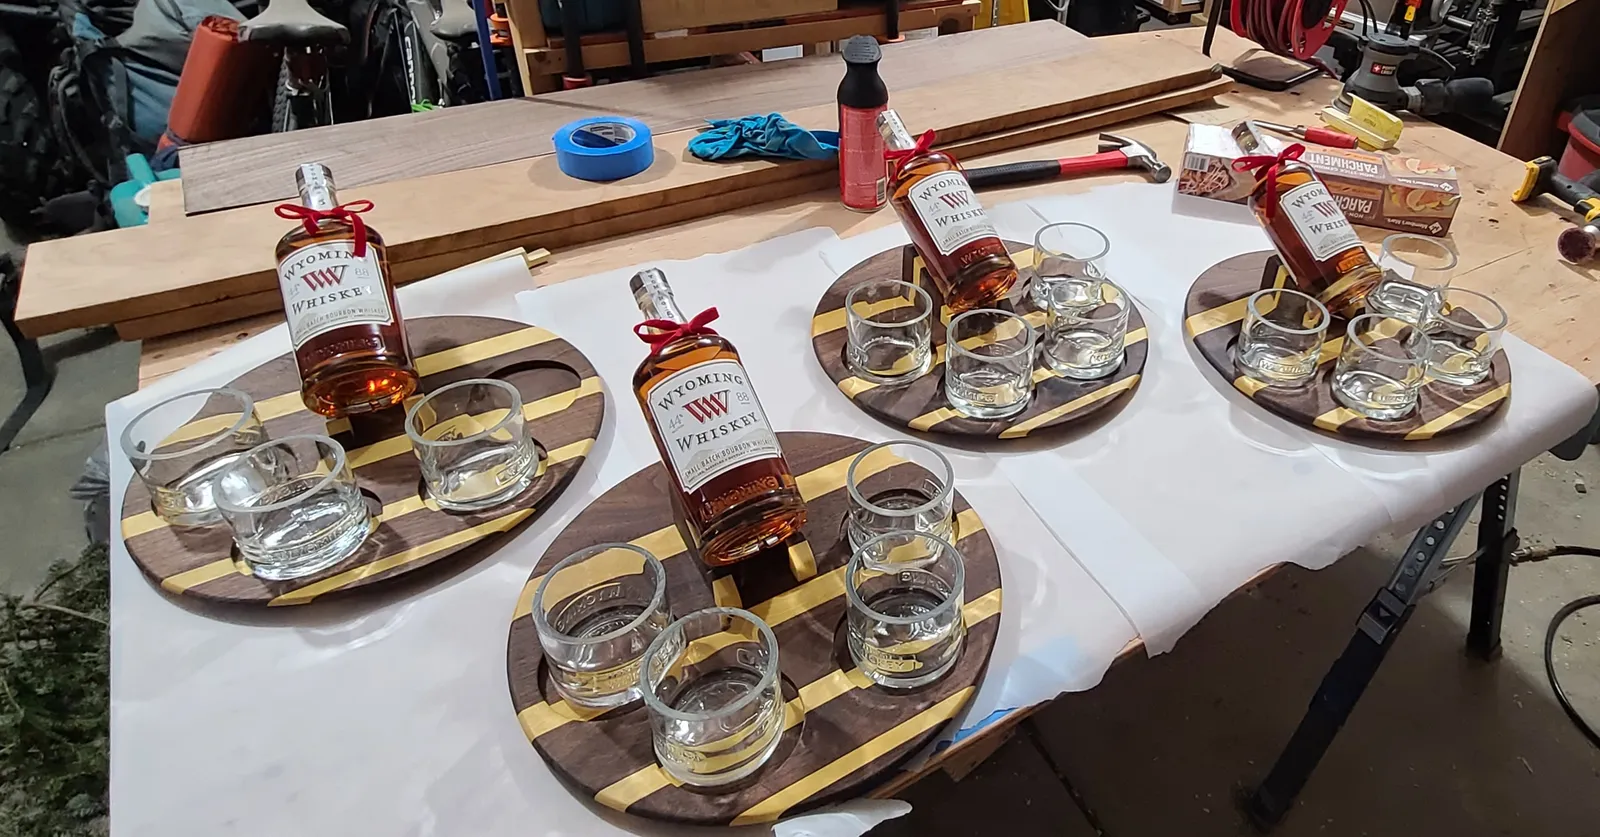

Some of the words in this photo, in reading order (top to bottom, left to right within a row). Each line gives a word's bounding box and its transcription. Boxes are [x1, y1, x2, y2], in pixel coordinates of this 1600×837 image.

[1309, 154, 1379, 175] PARCHMENT
[284, 250, 358, 281] WYOMIN
[658, 373, 743, 411] WYOMING
[676, 412, 760, 453] WHISKEY
[701, 452, 721, 468] BATCH
[721, 441, 752, 457] BOURBON
